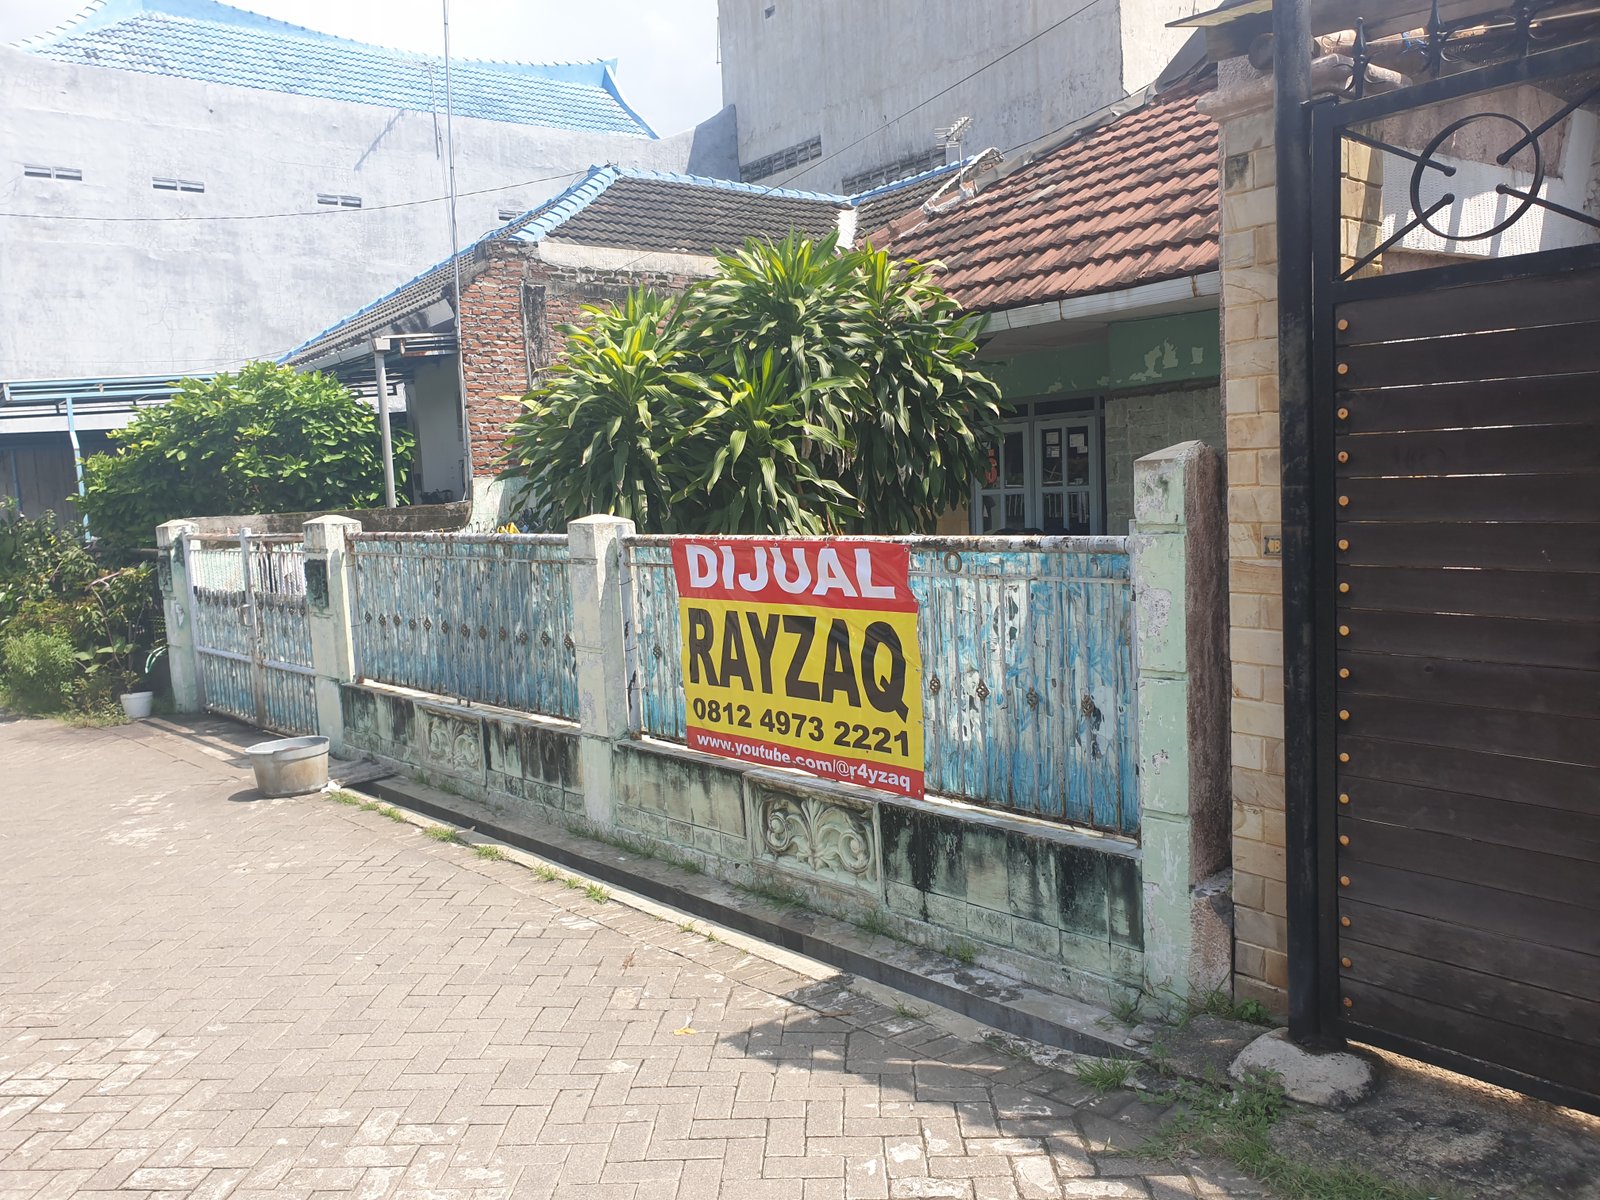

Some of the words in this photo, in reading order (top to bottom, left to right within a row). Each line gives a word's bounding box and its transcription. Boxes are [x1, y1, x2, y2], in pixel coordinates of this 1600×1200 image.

[685, 544, 896, 599] DIJUAL
[688, 607, 909, 723] RAYZAQ
[693, 697, 752, 728] 0812
[760, 709, 825, 742] 4973
[833, 721, 909, 757] 2221
[696, 734, 911, 791] www.youtube.com/@r4yzaq
